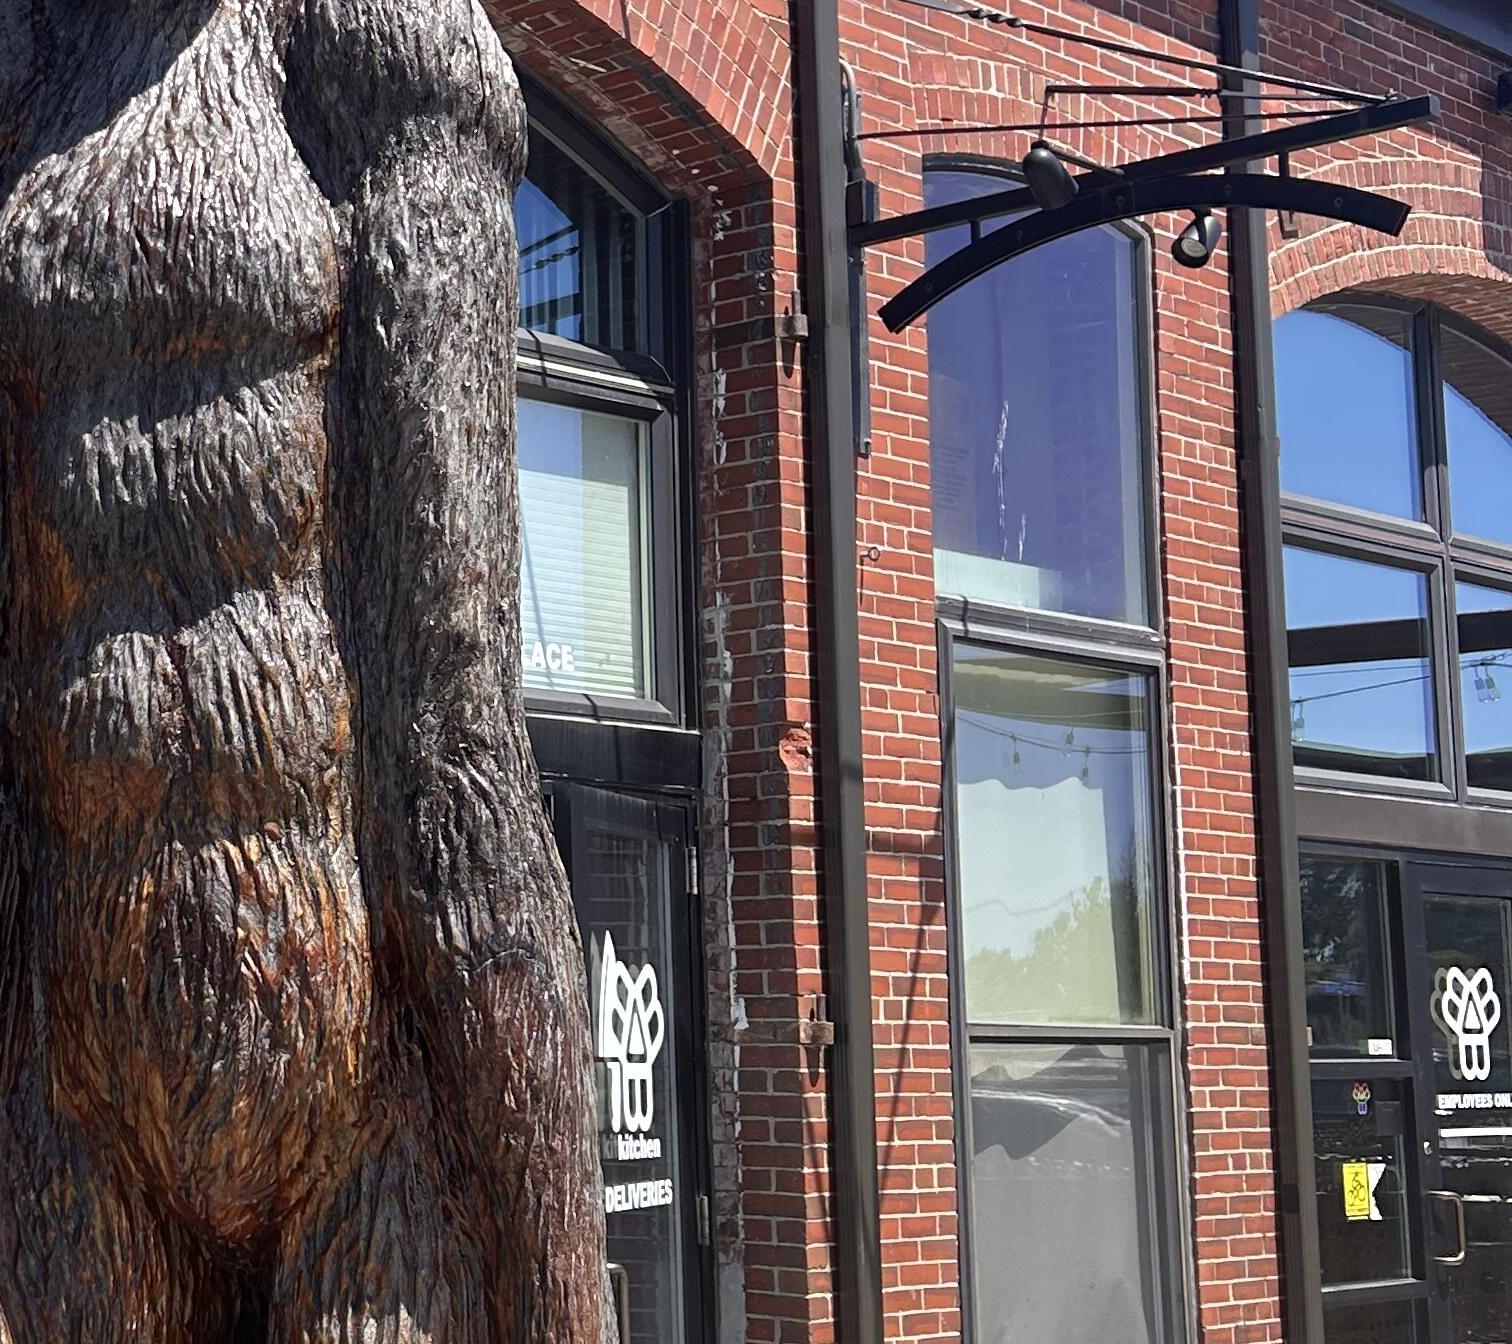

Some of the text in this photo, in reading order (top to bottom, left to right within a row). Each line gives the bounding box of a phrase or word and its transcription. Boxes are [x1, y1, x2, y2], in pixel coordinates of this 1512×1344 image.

[1437, 1093, 1493, 1109] EMPLOYEES
[617, 1133, 661, 1161] kitchen
[604, 1178, 673, 1214] DELIVERIES
